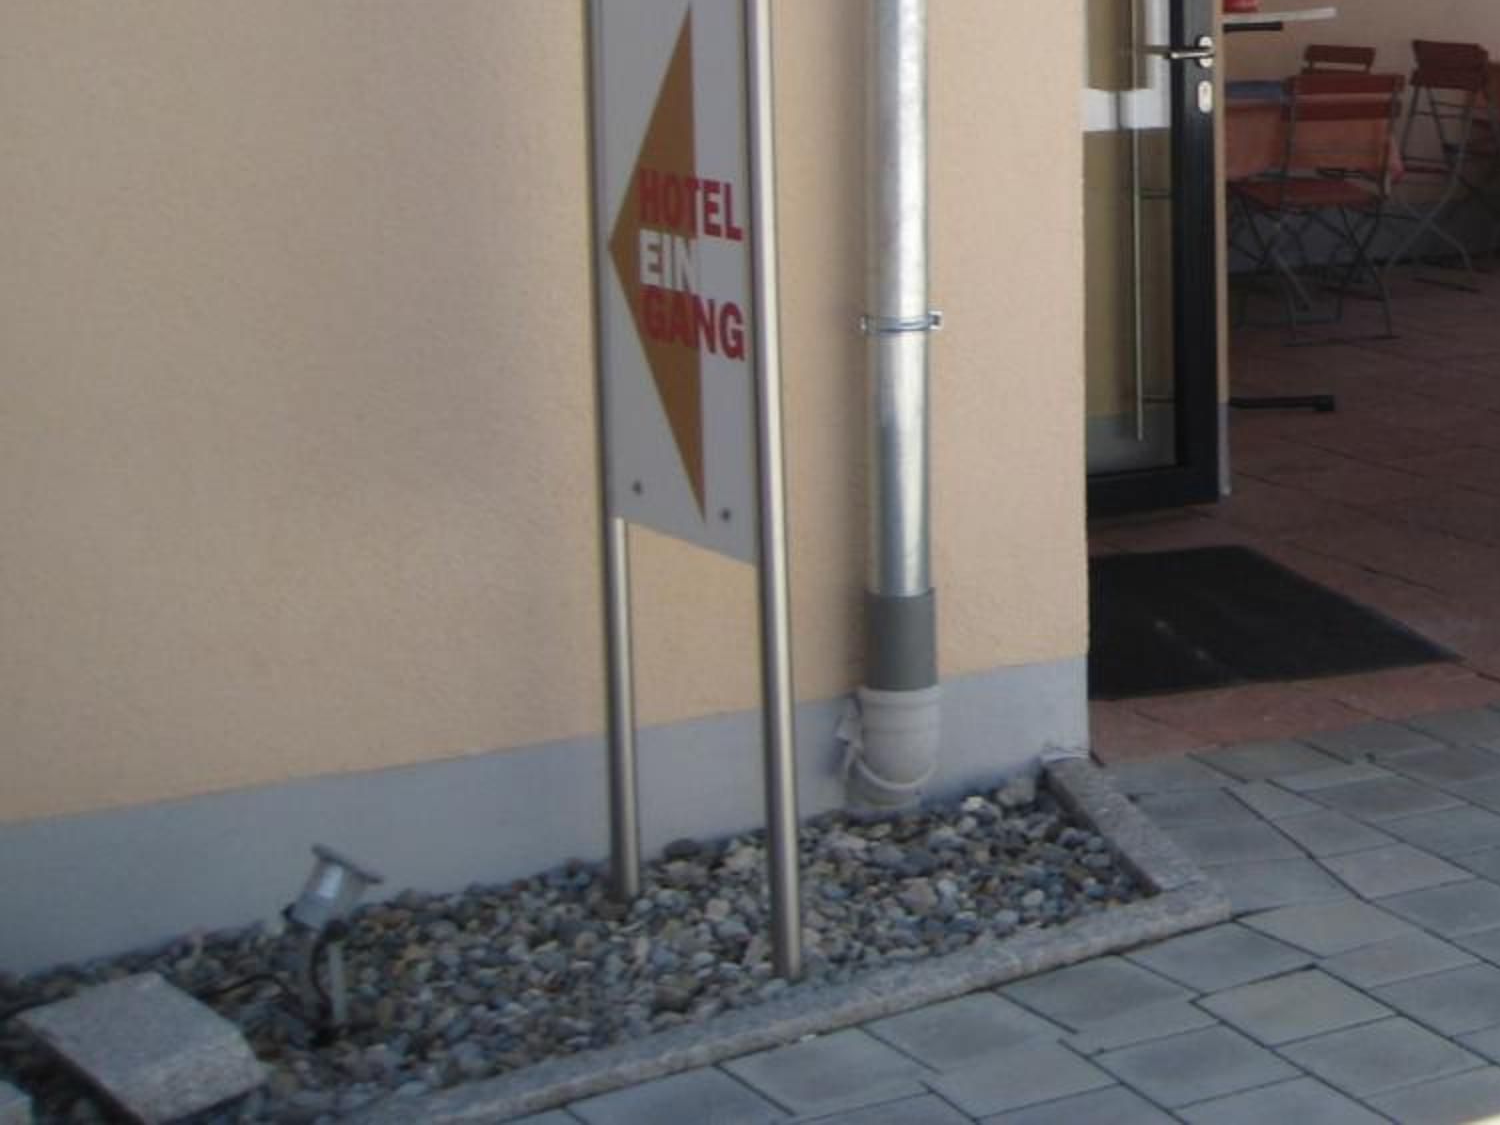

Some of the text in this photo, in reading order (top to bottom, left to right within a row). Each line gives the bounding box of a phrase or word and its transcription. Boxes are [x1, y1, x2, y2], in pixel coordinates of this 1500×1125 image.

[638, 167, 743, 242] HOTEL
[638, 227, 699, 292] EIN
[640, 284, 745, 362] GANG
